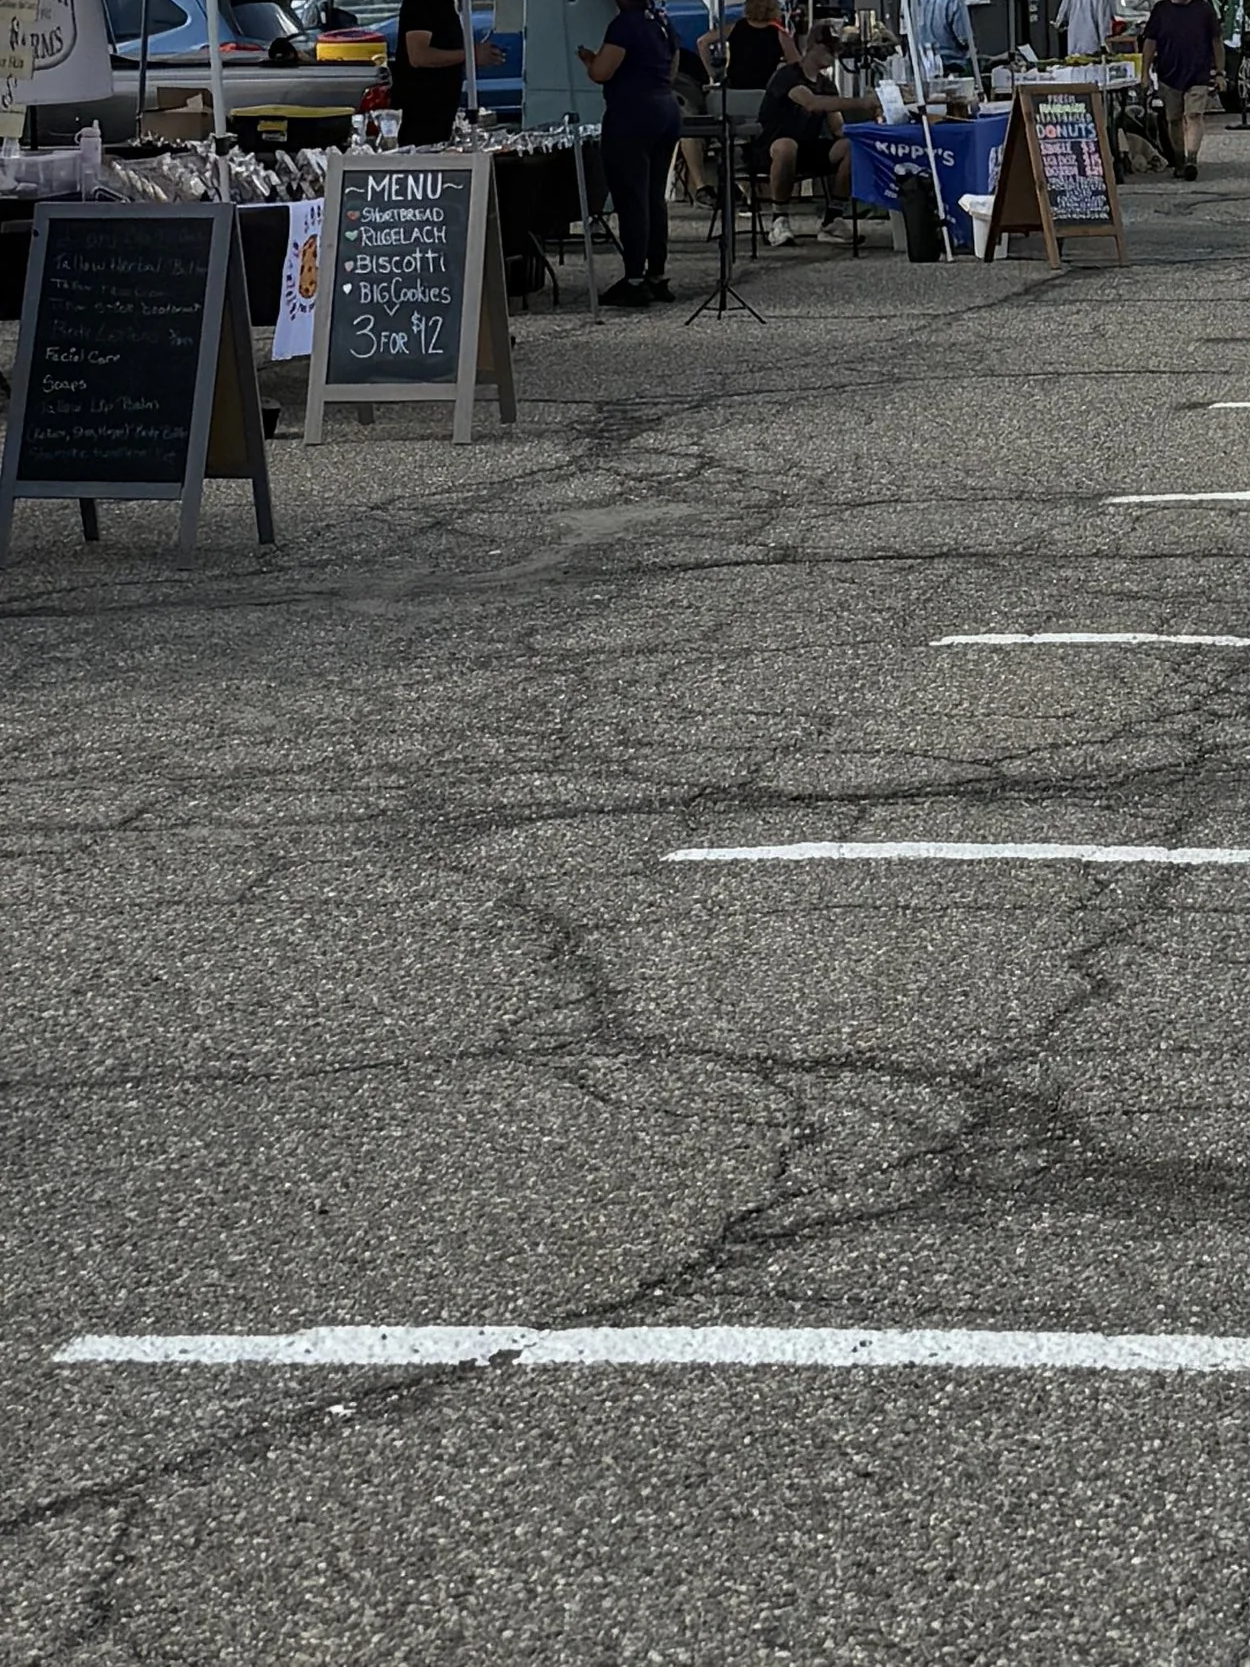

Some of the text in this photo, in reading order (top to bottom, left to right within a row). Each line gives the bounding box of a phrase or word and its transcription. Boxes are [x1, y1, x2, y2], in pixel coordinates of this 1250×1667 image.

[1036, 122, 1097, 139] DONUTS
[367, 172, 443, 202] MENU
[360, 207, 444, 223] SHORTBREAD
[359, 226, 447, 247] RUGELACH
[359, 281, 389, 304] BIG
[350, 310, 444, 359] 3 FOR $12
[44, 345, 84, 363] Facial
[41, 374, 88, 394] Soaps
